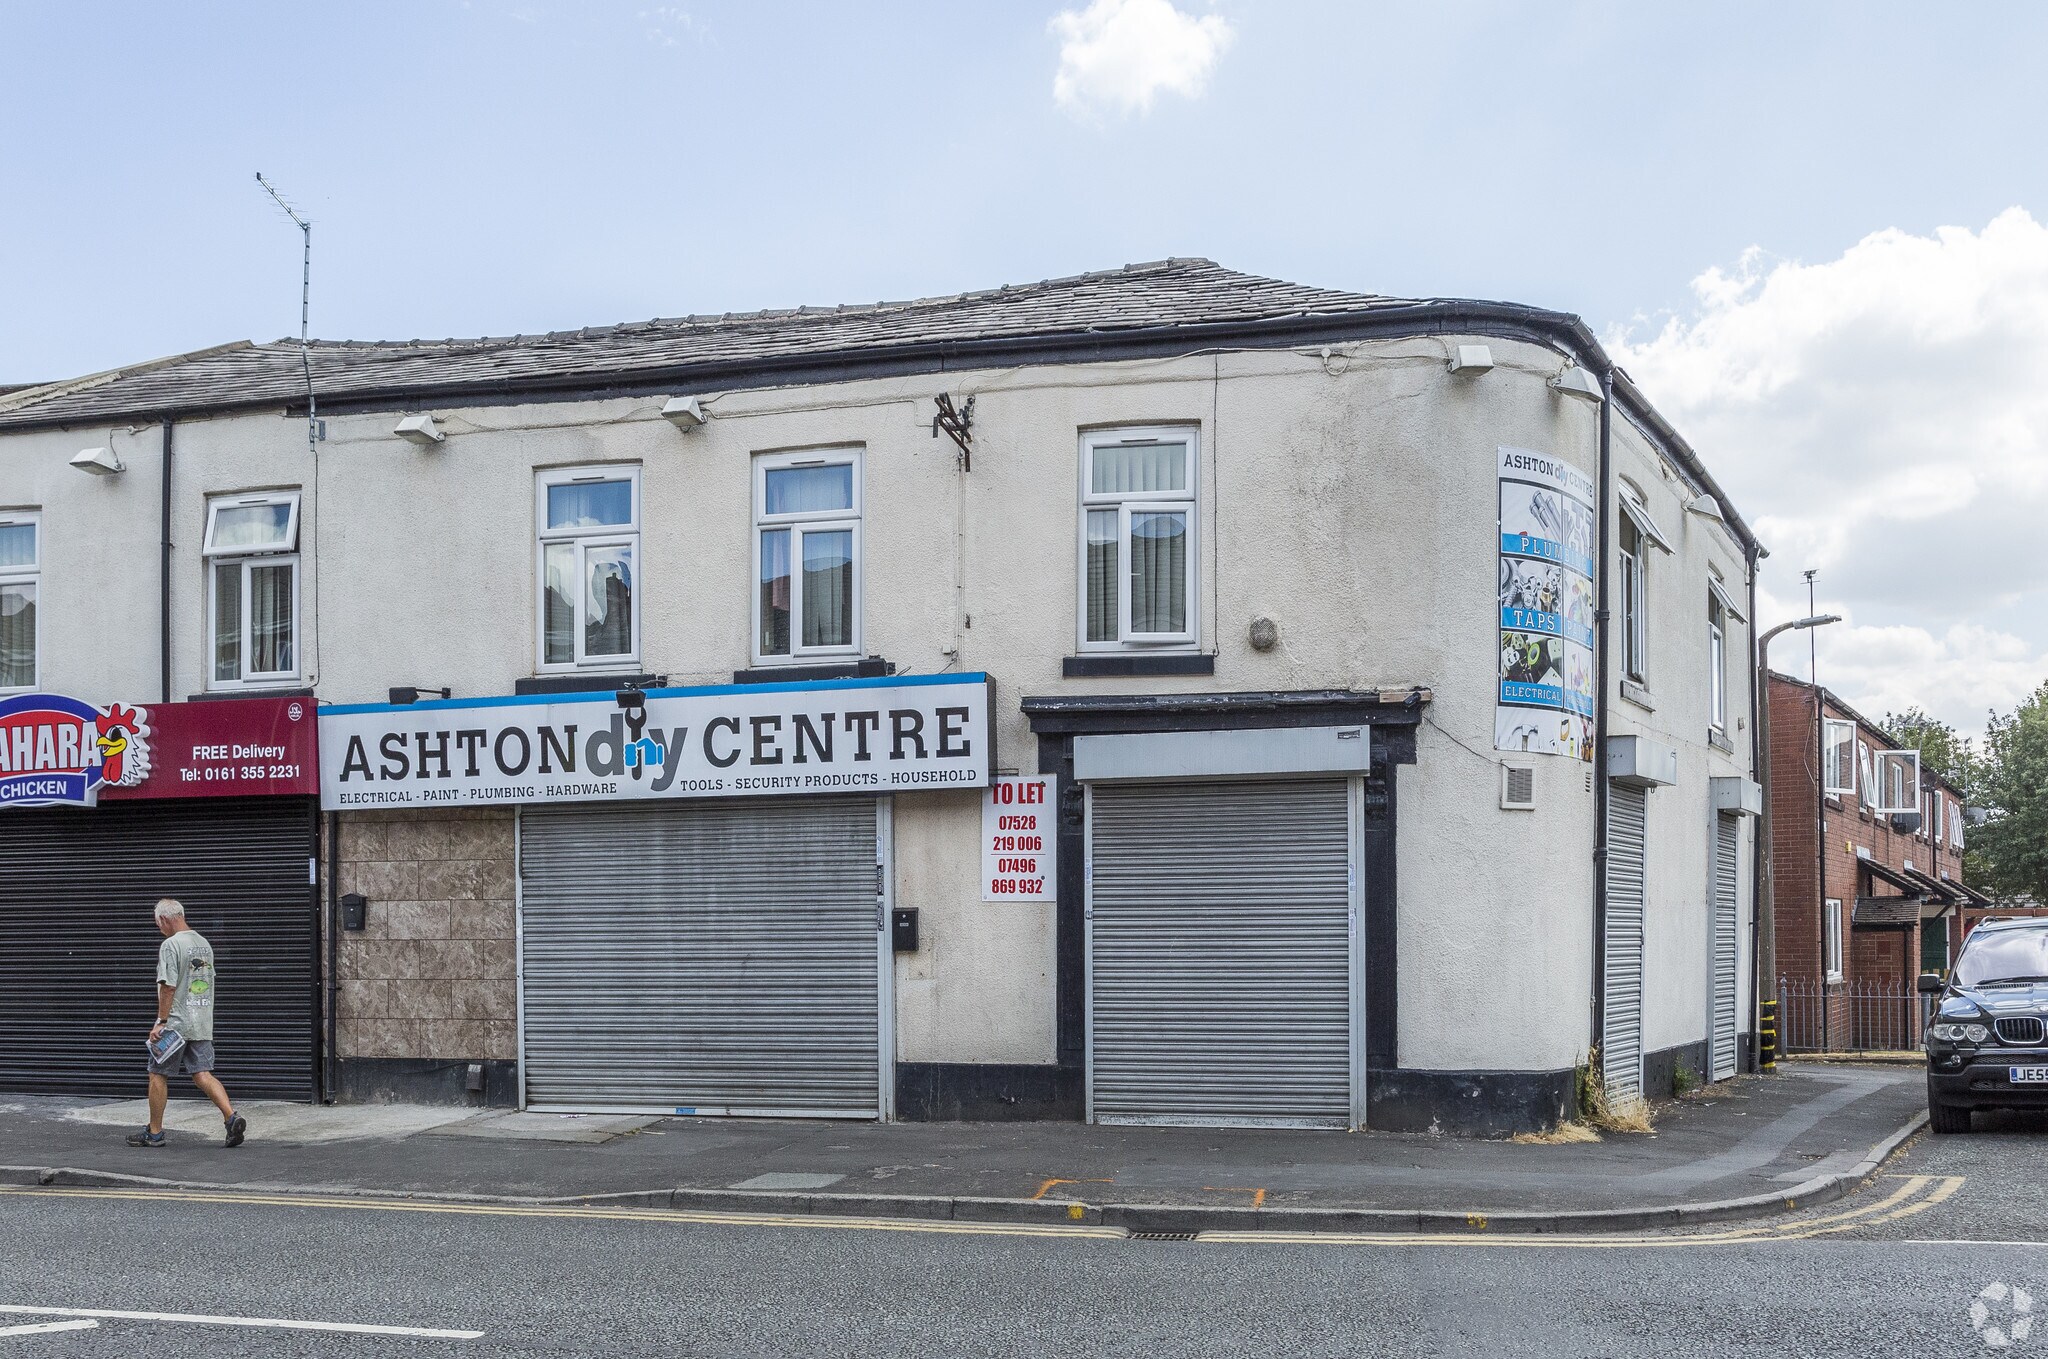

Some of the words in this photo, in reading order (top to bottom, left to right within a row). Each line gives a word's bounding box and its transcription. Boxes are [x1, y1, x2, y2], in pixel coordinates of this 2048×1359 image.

[1504, 454, 1553, 476] ASHTON
[1569, 472, 1593, 498] CENTRE
[1514, 610, 1555, 630] TAPS
[1505, 686, 1562, 702] ELECTRICAL
[193, 746, 228, 760] FREE
[233, 745, 285, 761] Delivery
[339, 724, 578, 783] ASHTON
[703, 706, 971, 768] CENTRE
[180, 768, 200, 782] Tel:
[205, 767, 235, 781] 0161
[241, 766, 265, 780] 355
[269, 765, 300, 779] 2231
[680, 779, 723, 791] TOOLS
[735, 775, 800, 789] SECURITY
[804, 773, 878, 786] PRODUCTS
[891, 769, 977, 784] HOUSEHOLD
[1, 781, 67, 799] CHICKEN
[339, 790, 413, 804] ELECTRICAL
[423, 788, 459, 801] PAINT
[470, 786, 535, 799] PLUMBING
[546, 782, 617, 797] HARDWARE
[993, 783, 1013, 804] TO
[1018, 782, 1046, 804] LET
[999, 815, 1036, 831] 07528
[993, 837, 1015, 852] 219
[1018, 835, 1041, 851] 006
[998, 858, 1036, 874] 07496
[992, 879, 1015, 894] 869
[1018, 879, 1042, 893] 932
